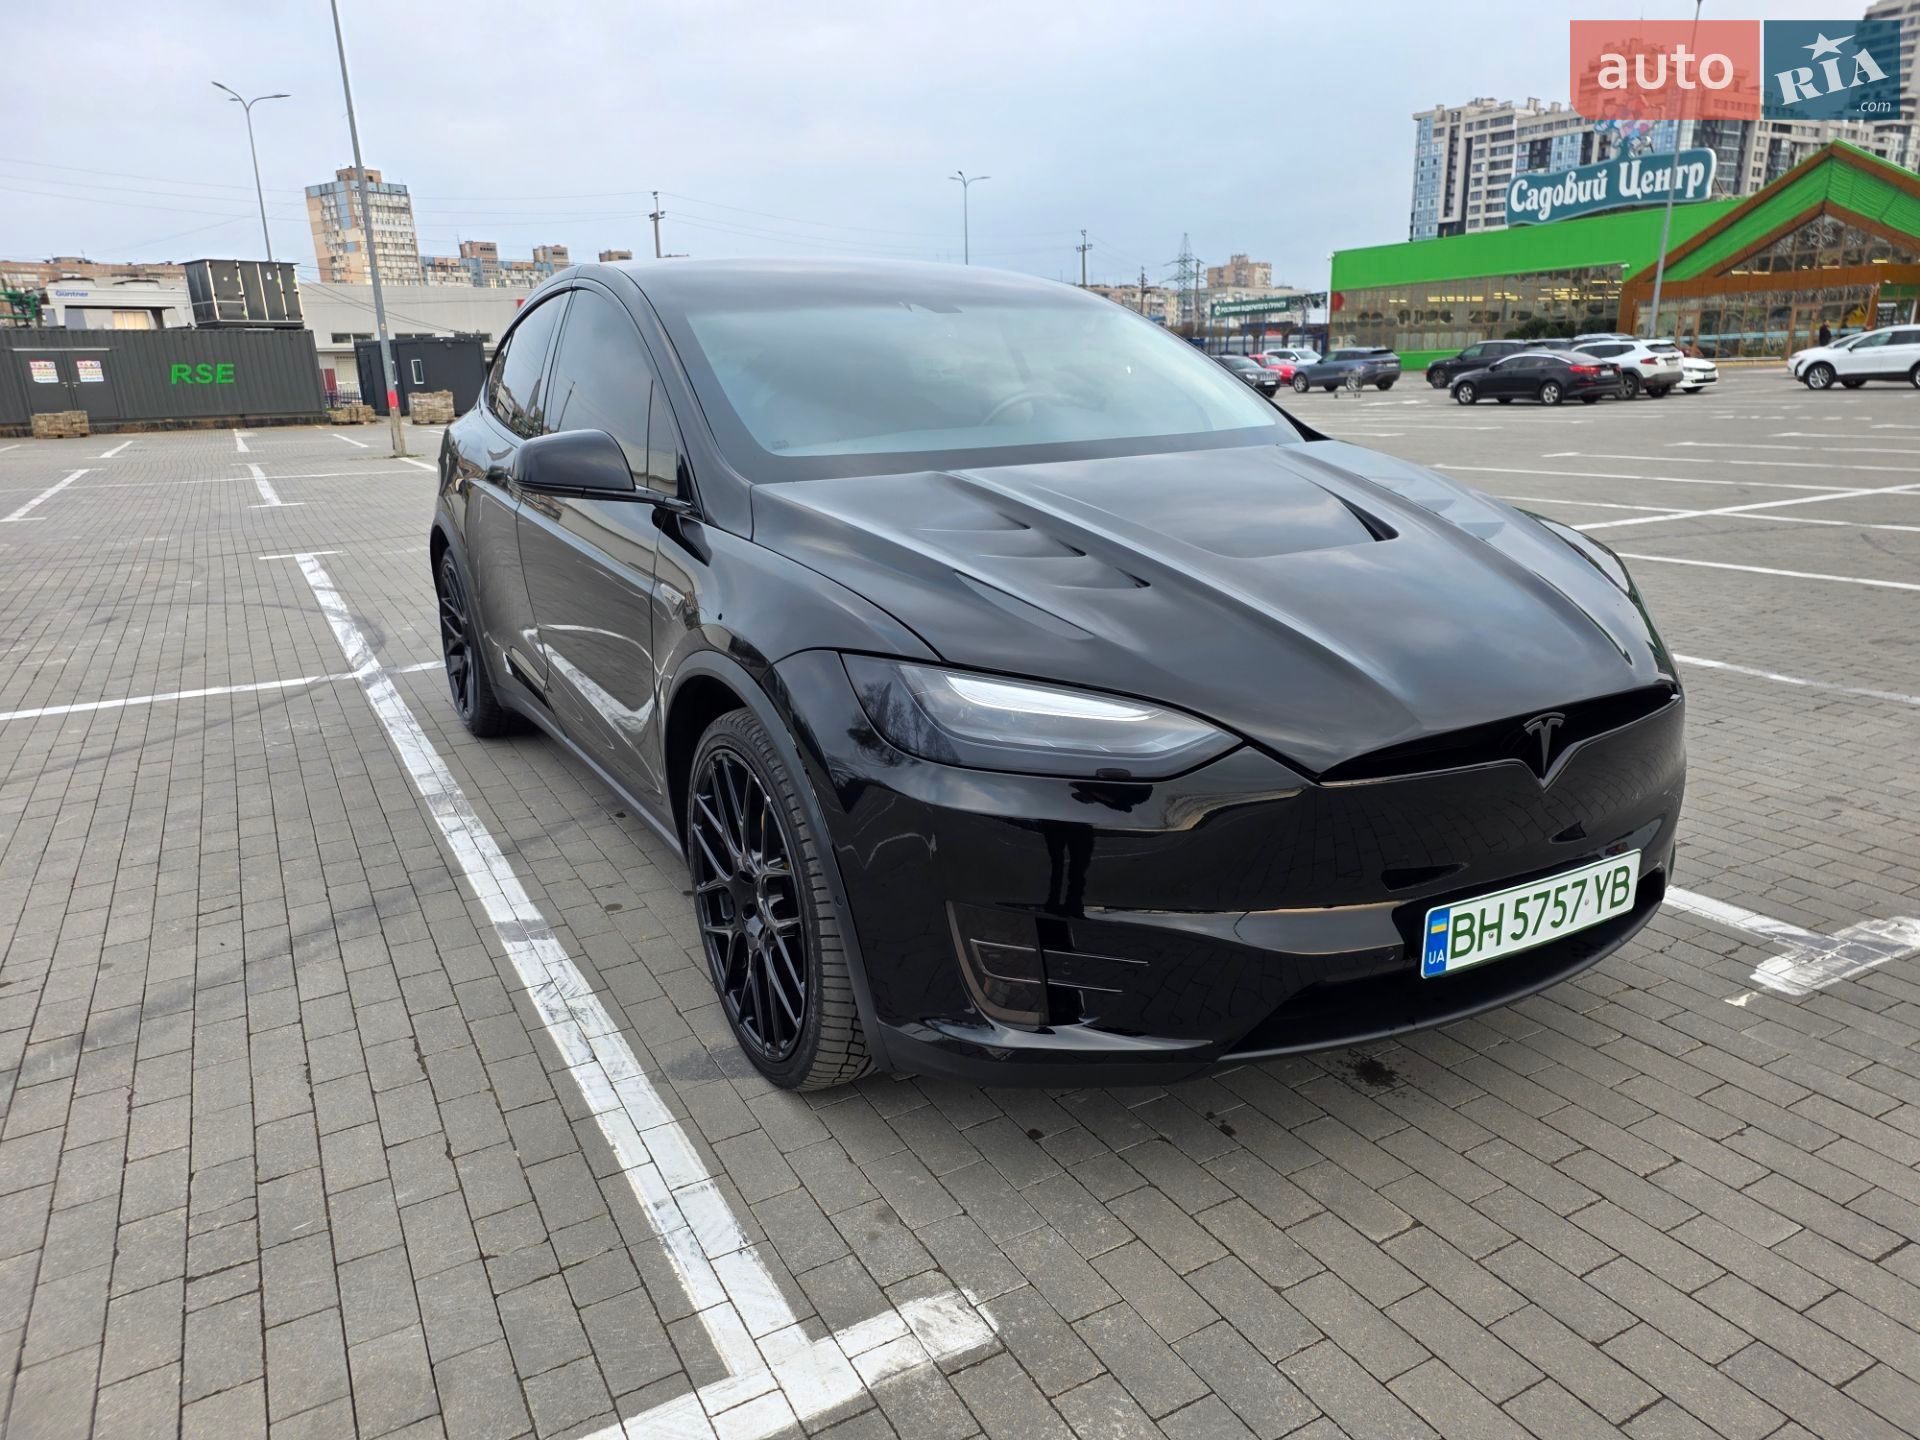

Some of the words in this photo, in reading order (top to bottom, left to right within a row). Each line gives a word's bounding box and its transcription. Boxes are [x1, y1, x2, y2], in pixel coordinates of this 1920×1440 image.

[1510, 168, 1609, 221] Садовий
[1618, 159, 1705, 200] Центр
[171, 363, 235, 385] RSE
[1449, 902, 1505, 960] BH
[1510, 878, 1588, 941] 5757
[1595, 865, 1631, 915] YB
[1428, 948, 1445, 965] UA
